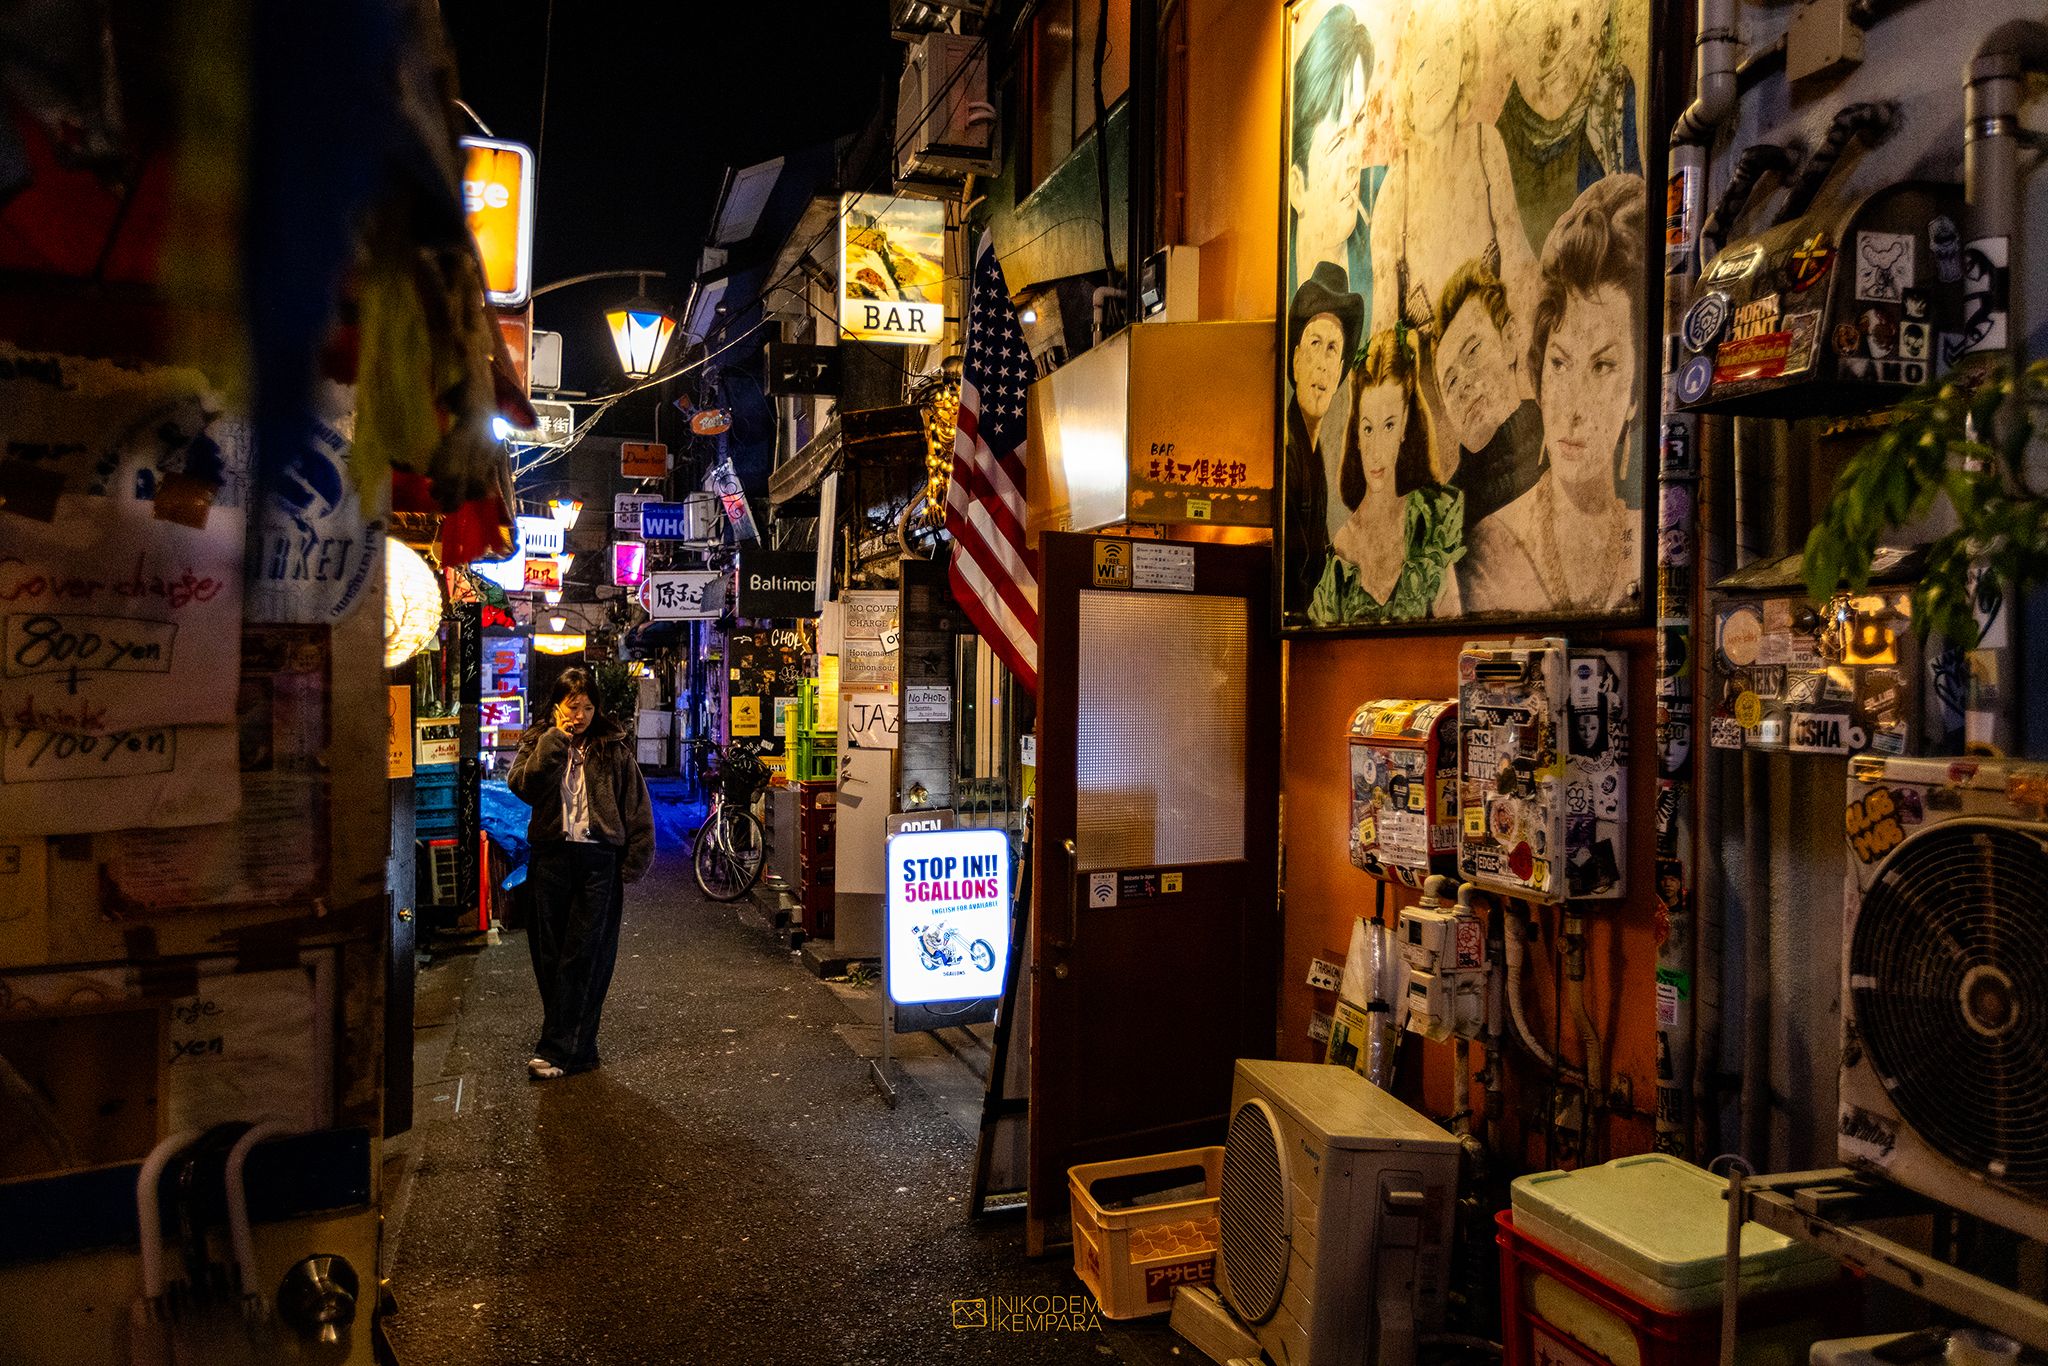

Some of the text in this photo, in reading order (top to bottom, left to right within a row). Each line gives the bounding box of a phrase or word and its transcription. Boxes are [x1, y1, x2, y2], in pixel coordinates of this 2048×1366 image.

[863, 305, 926, 333] BAR
[1150, 442, 1175, 456] BAR
[1105, 557, 1120, 565] FREE
[1097, 564, 1128, 578] WiFi
[656, 581, 708, 608] 原子心
[849, 604, 898, 613] NO COVER
[849, 619, 888, 627] CHARGE
[16, 616, 160, 667] 800 yen
[849, 663, 876, 671] Lemon
[102, 731, 165, 761] yen
[903, 854, 998, 882] STOP IN!!
[905, 878, 998, 903] 5GALLONS
[931, 901, 998, 916] ENGLISH FOR AVAILABLE
